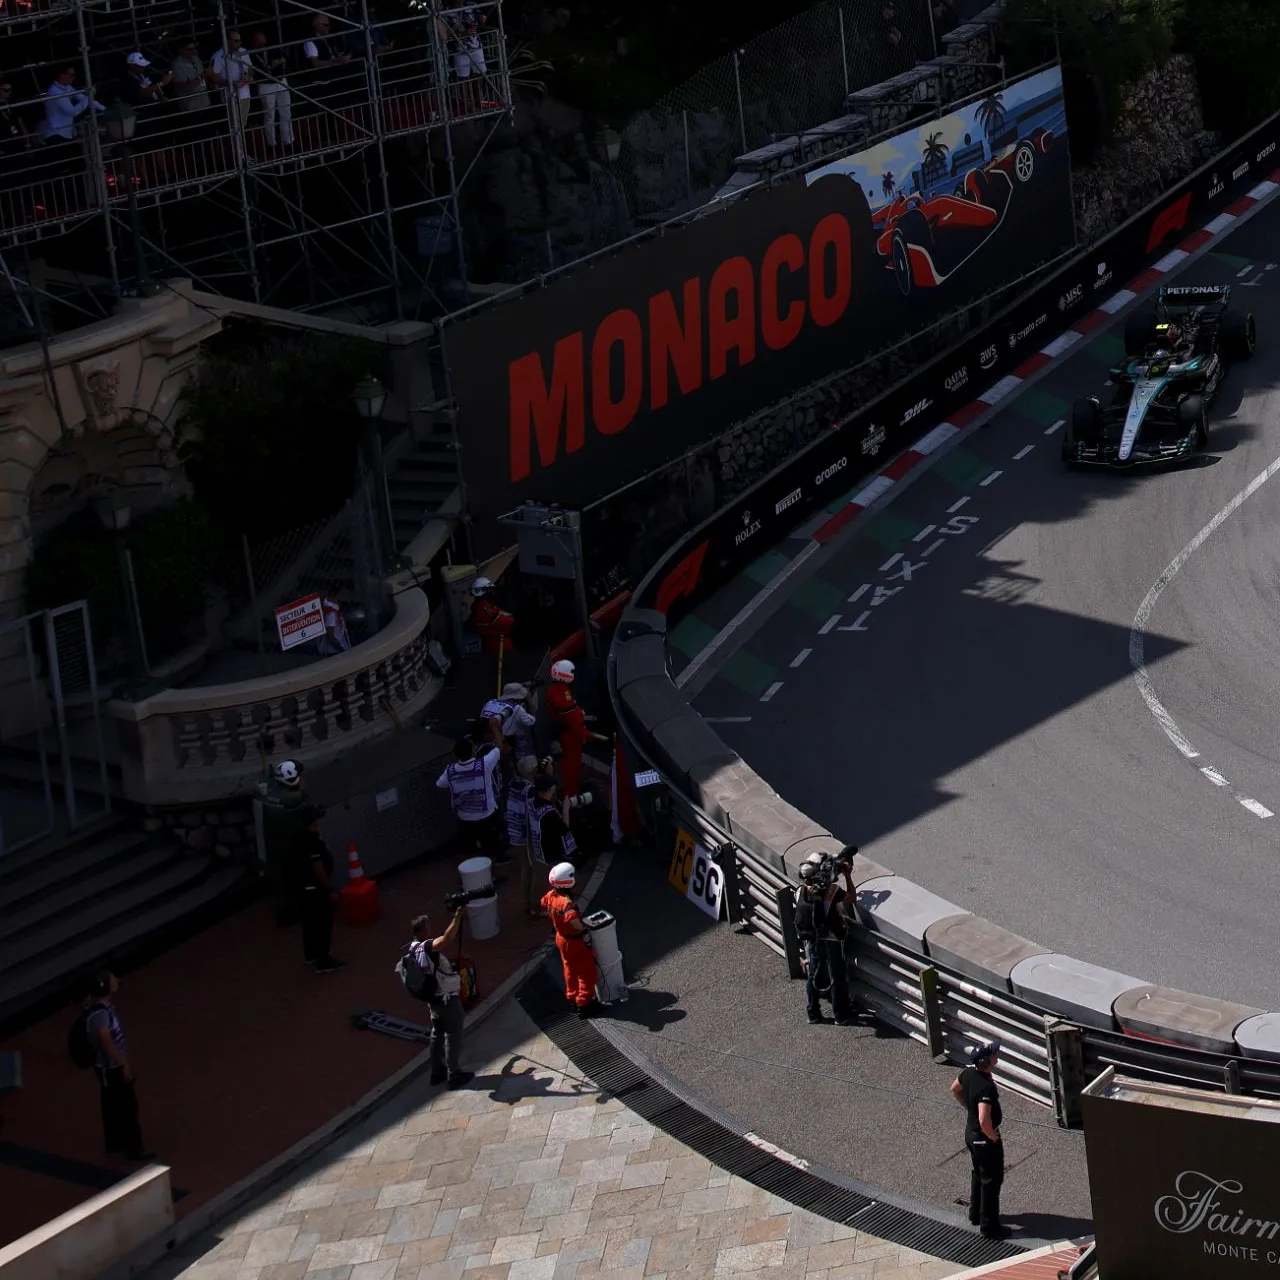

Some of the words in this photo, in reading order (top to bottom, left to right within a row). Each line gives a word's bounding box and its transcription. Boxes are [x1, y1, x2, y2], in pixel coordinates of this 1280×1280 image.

[1167, 285, 1220, 295] PETRONAS
[1017, 312, 1048, 340] crypto.com
[509, 213, 852, 484] MONACO
[980, 343, 997, 362] aws
[944, 365, 968, 391] QATAR
[814, 456, 848, 485] aramco
[775, 487, 803, 516] PIRELLI
[735, 519, 763, 547] ROLEX
[280, 607, 305, 622] SECTEUR
[311, 602, 316, 610] 6
[282, 613, 320, 634] INTERVENTION
[301, 630, 306, 638] 6
[674, 840, 694, 885] FC
[693, 857, 719, 907] SC
[1203, 1240, 1258, 1262] MONTE
